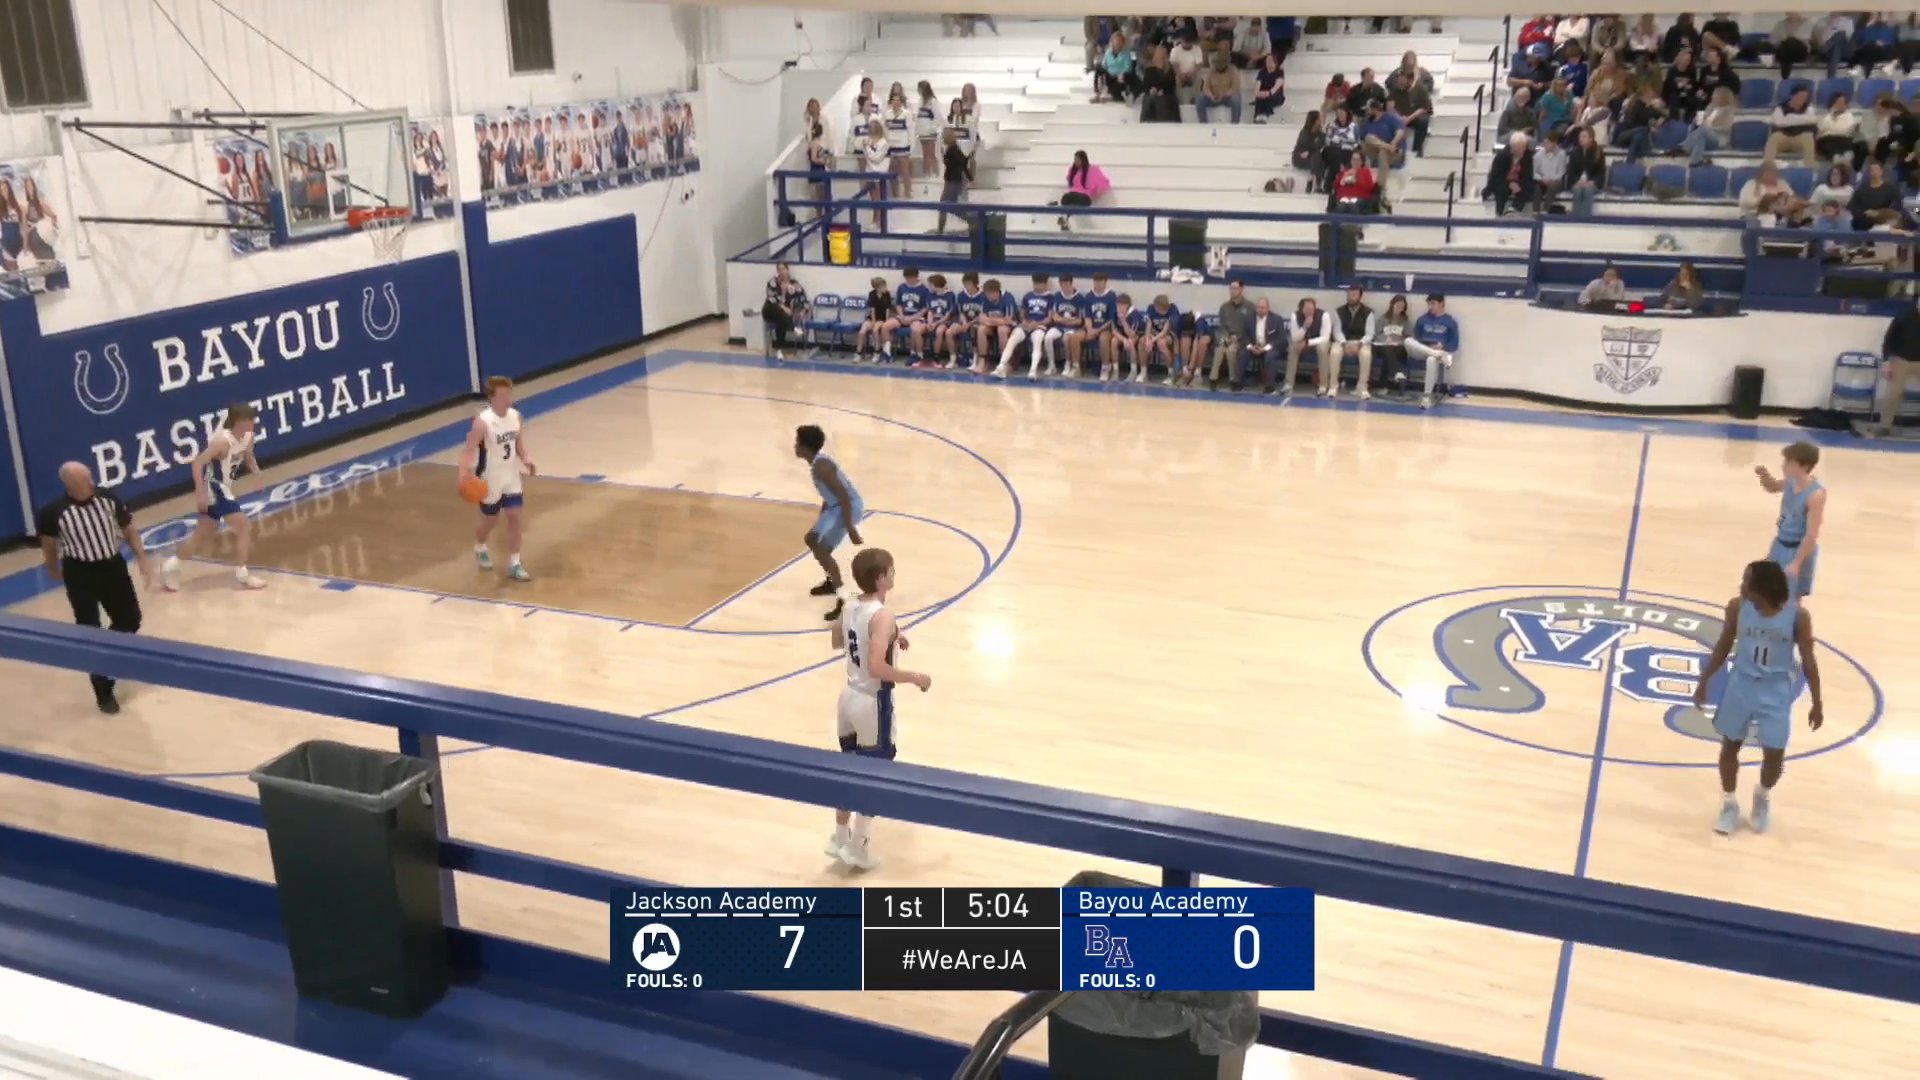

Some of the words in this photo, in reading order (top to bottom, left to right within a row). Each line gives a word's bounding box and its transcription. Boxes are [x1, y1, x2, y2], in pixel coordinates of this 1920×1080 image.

[152, 300, 340, 393] BAYOU
[502, 443, 511, 461] 3
[1544, 602, 1703, 632] COLTS
[847, 628, 861, 669] 2
[1753, 645, 1769, 666] 11
